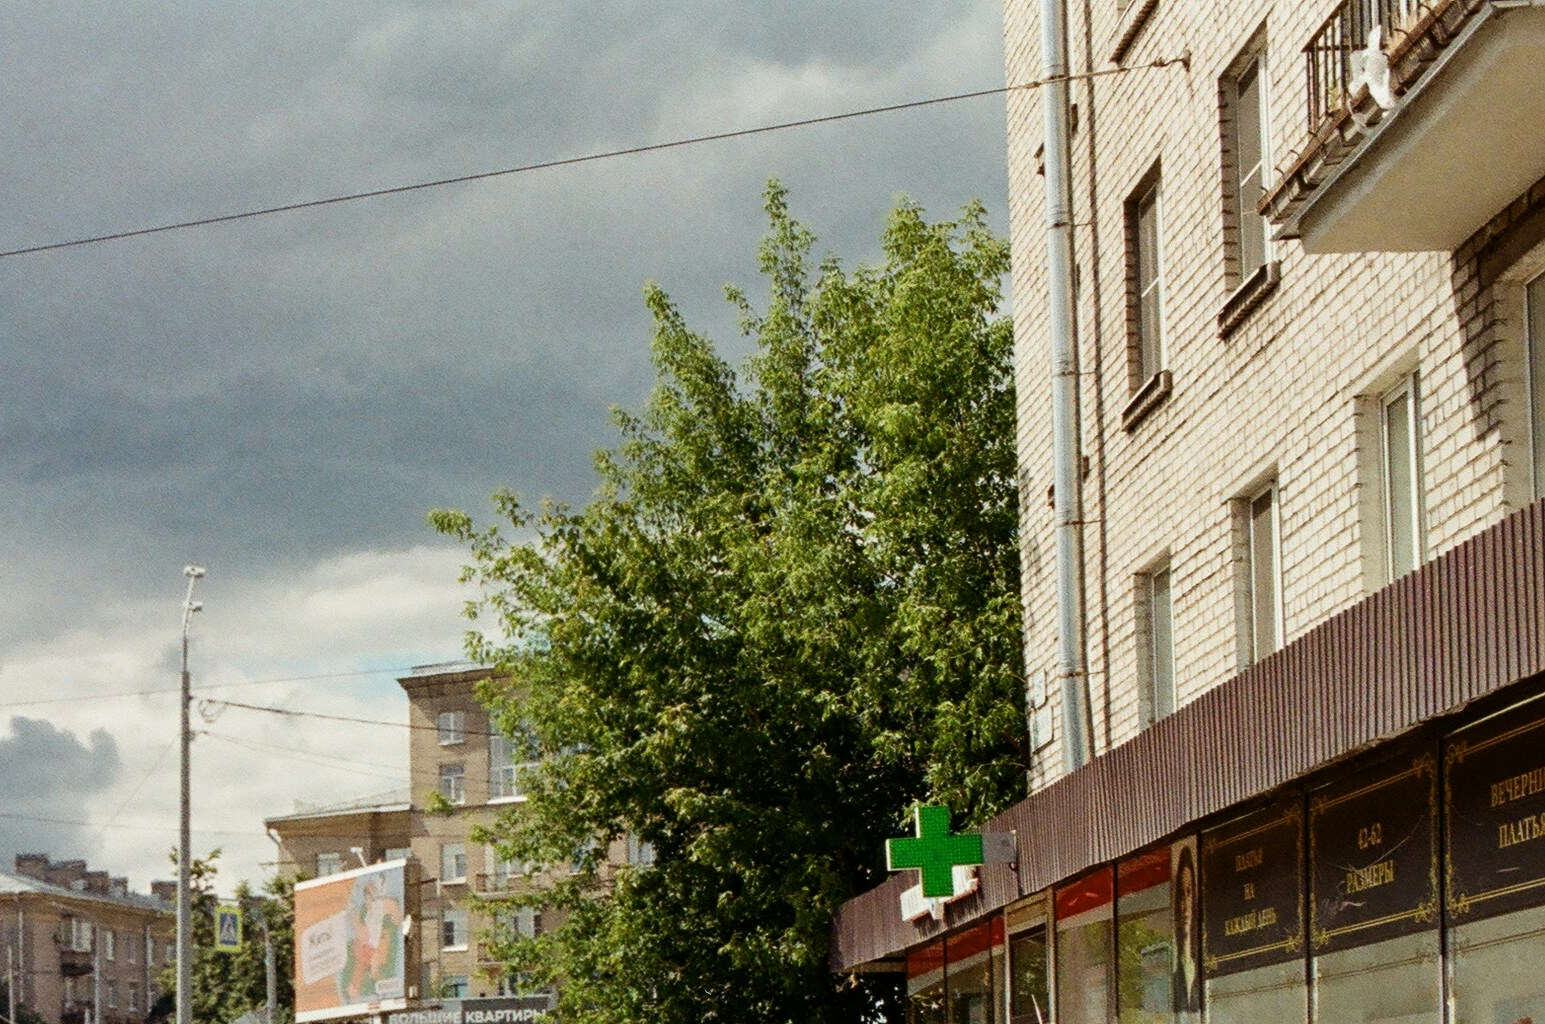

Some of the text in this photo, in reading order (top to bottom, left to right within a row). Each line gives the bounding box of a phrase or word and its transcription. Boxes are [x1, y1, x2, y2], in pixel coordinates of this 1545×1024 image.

[1358, 822, 1382, 850] 42-62
[1346, 860, 1395, 894] РАЗМЕРЫ
[465, 1008, 547, 1024] КВАРТИРЫ
